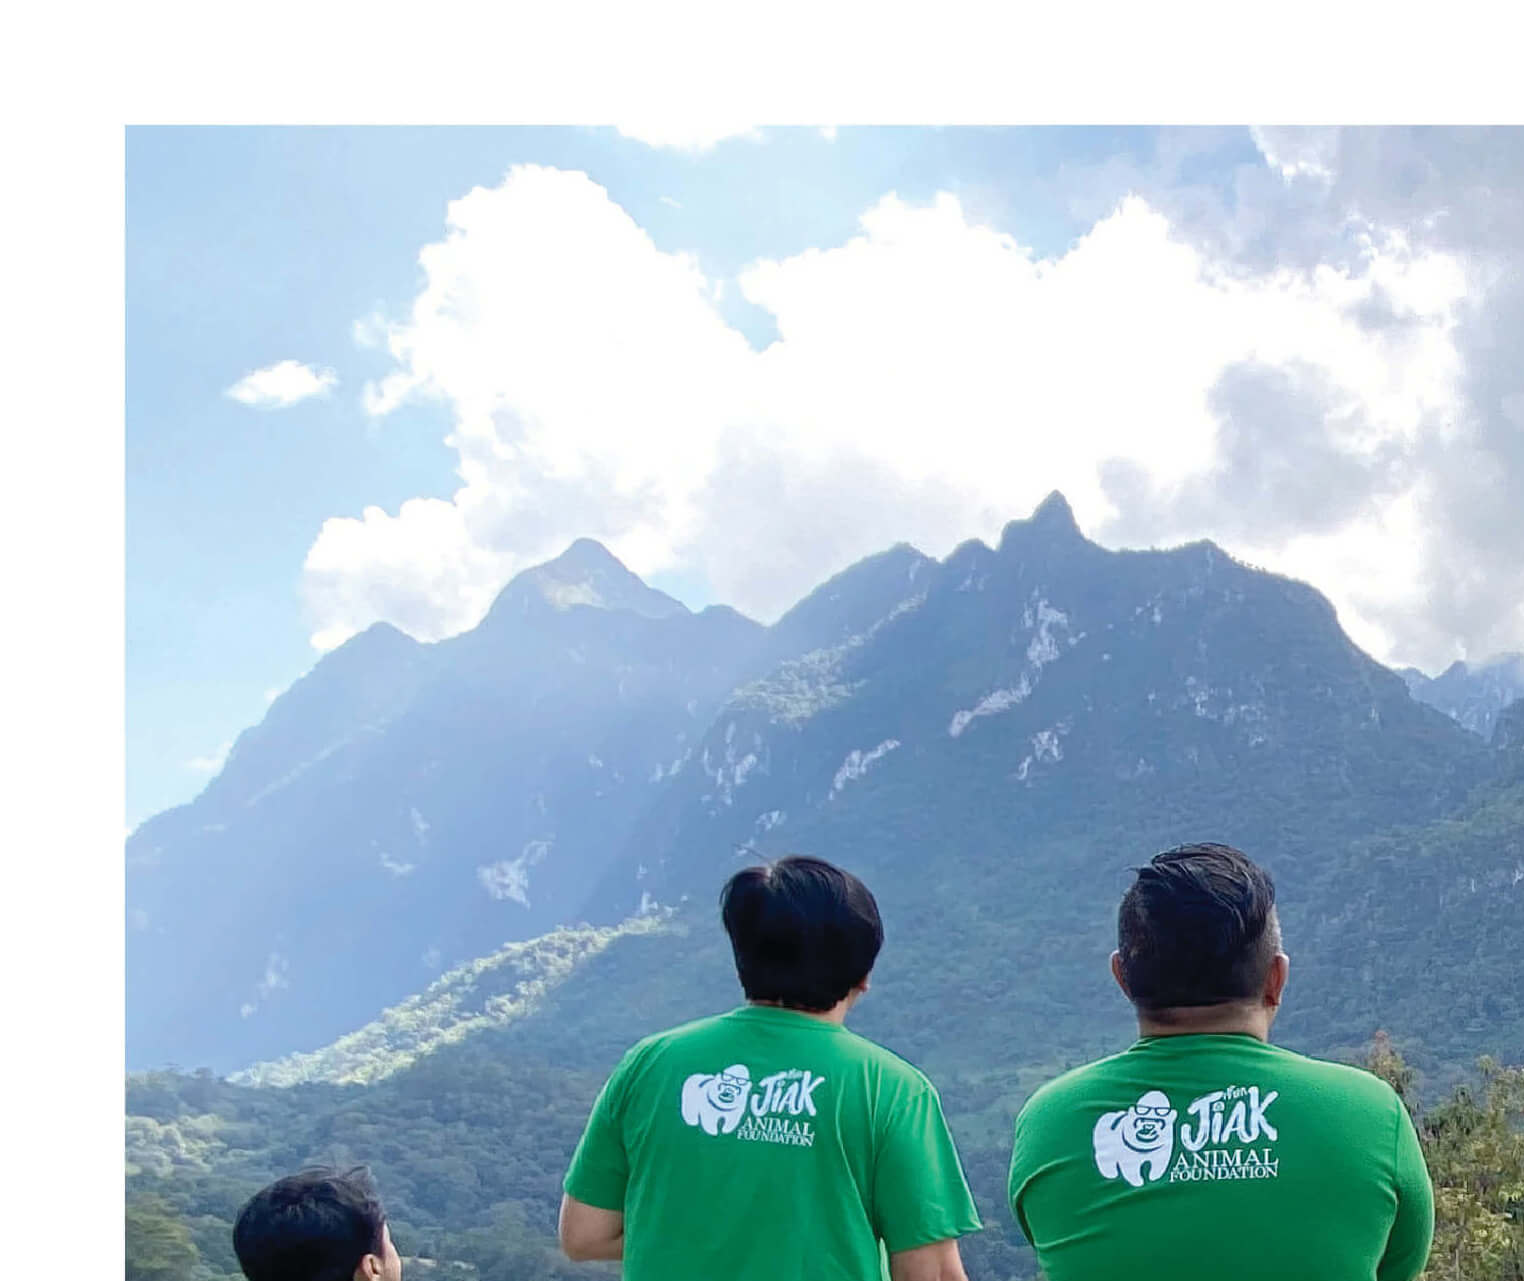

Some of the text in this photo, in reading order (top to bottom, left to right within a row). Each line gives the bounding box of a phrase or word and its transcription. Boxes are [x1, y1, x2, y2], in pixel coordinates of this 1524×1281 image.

[736, 1128, 815, 1147] FOUNDATION
[741, 1116, 815, 1138] ANIMAL
[1173, 1148, 1279, 1170] ANIMAL
[1169, 1163, 1279, 1183] FOUNDATION
